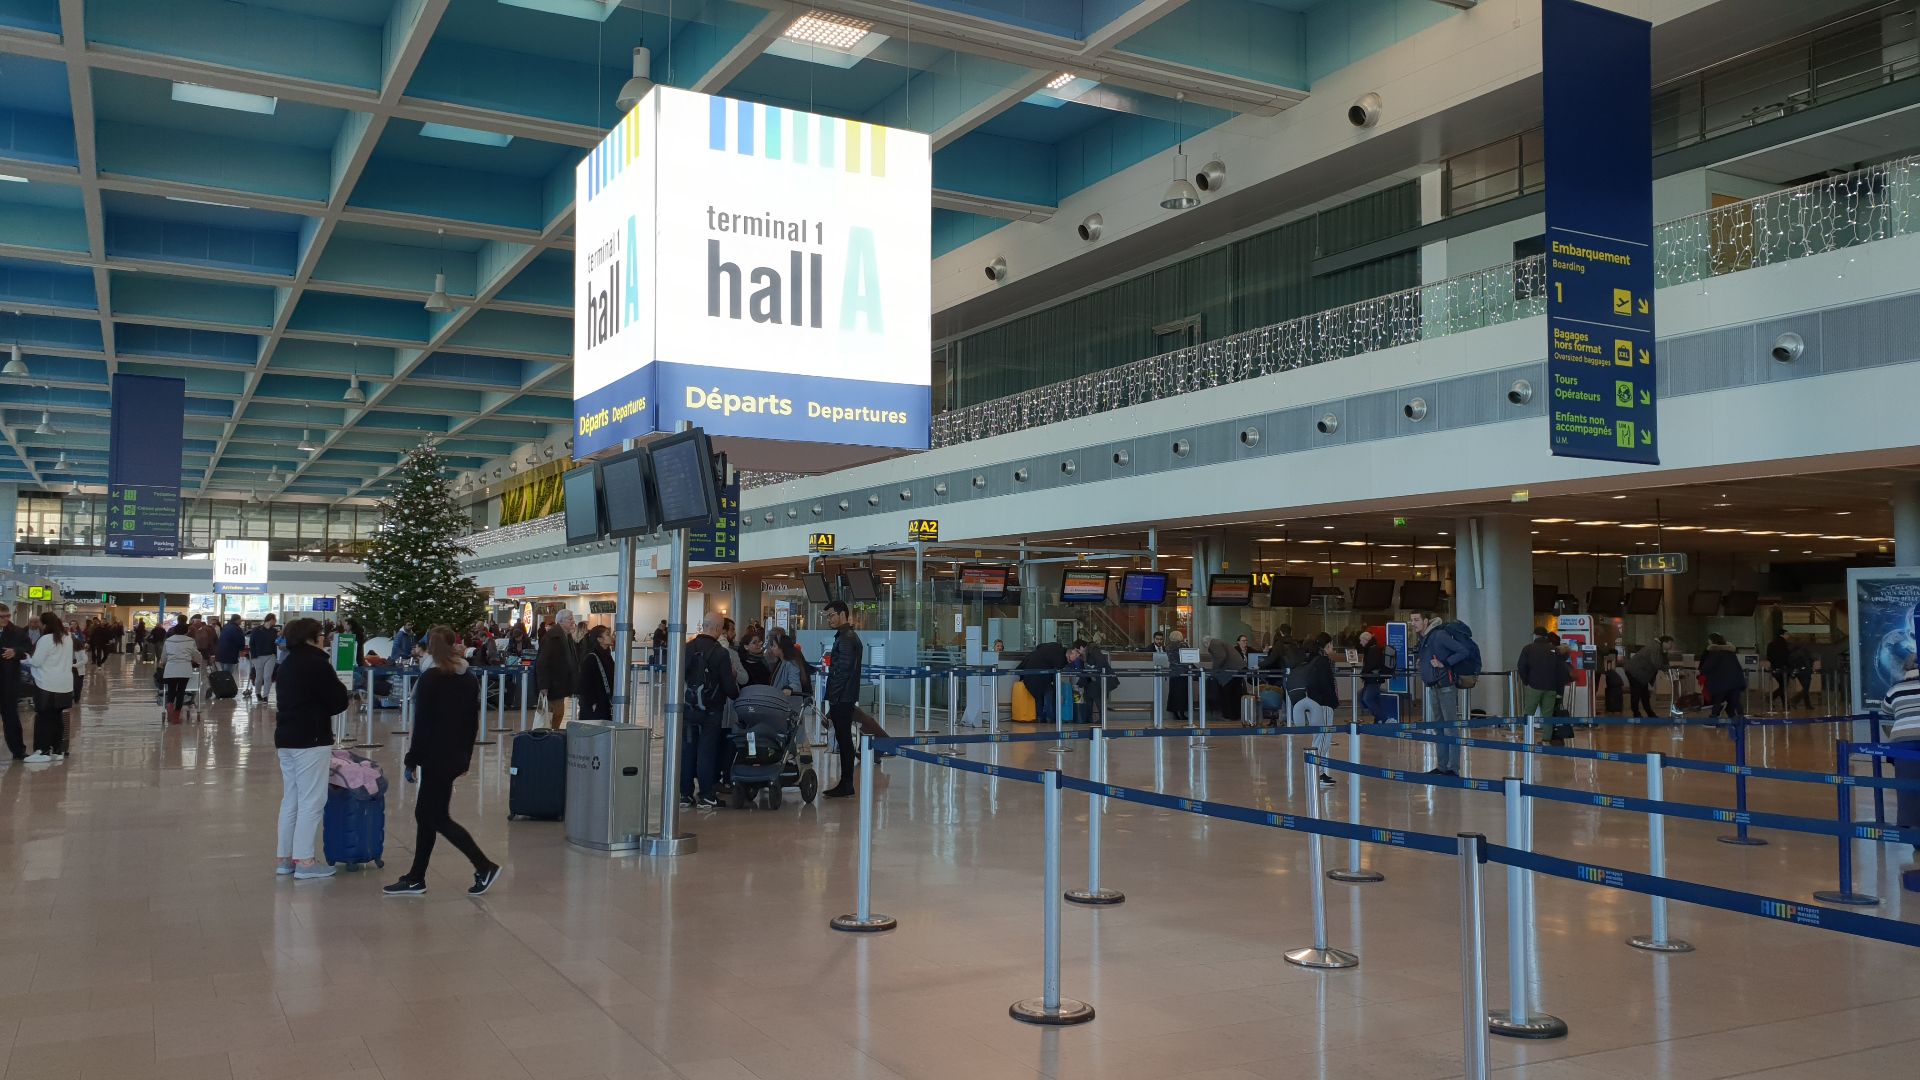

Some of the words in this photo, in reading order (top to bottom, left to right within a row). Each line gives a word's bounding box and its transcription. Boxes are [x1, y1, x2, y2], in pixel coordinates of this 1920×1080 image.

[707, 205, 807, 243] terminal
[815, 221, 823, 245] 1
[588, 232, 615, 274] terminal
[1552, 240, 1631, 266] Embarquement
[1552, 258, 1585, 274] Boarding
[587, 260, 620, 350] hall
[624, 214, 640, 329] A
[707, 238, 823, 329] hall
[839, 225, 884, 334] A
[1555, 281, 1562, 304] 1
[1554, 327, 1589, 341] Bagages
[1554, 338, 1573, 350] hors
[1574, 340, 1602, 354] format
[1554, 352, 1583, 362] Oversized
[1584, 356, 1612, 367] baggages
[1554, 373, 1578, 385] Tours
[1554, 387, 1601, 402] Opérateurs
[686, 386, 793, 416] Départs
[808, 401, 907, 424] Departures
[579, 408, 609, 437] Départs
[612, 396, 646, 423] Departures
[1555, 411, 1588, 423] Enfants
[1589, 416, 1605, 425] non
[1555, 423, 1612, 437] accompagnés
[1555, 436, 1569, 444] U.M.
[908, 521, 918, 533] A2
[920, 521, 938, 533] A2
[809, 534, 817, 545] A1
[818, 534, 833, 545] A1
[224, 562, 247, 576] hall
